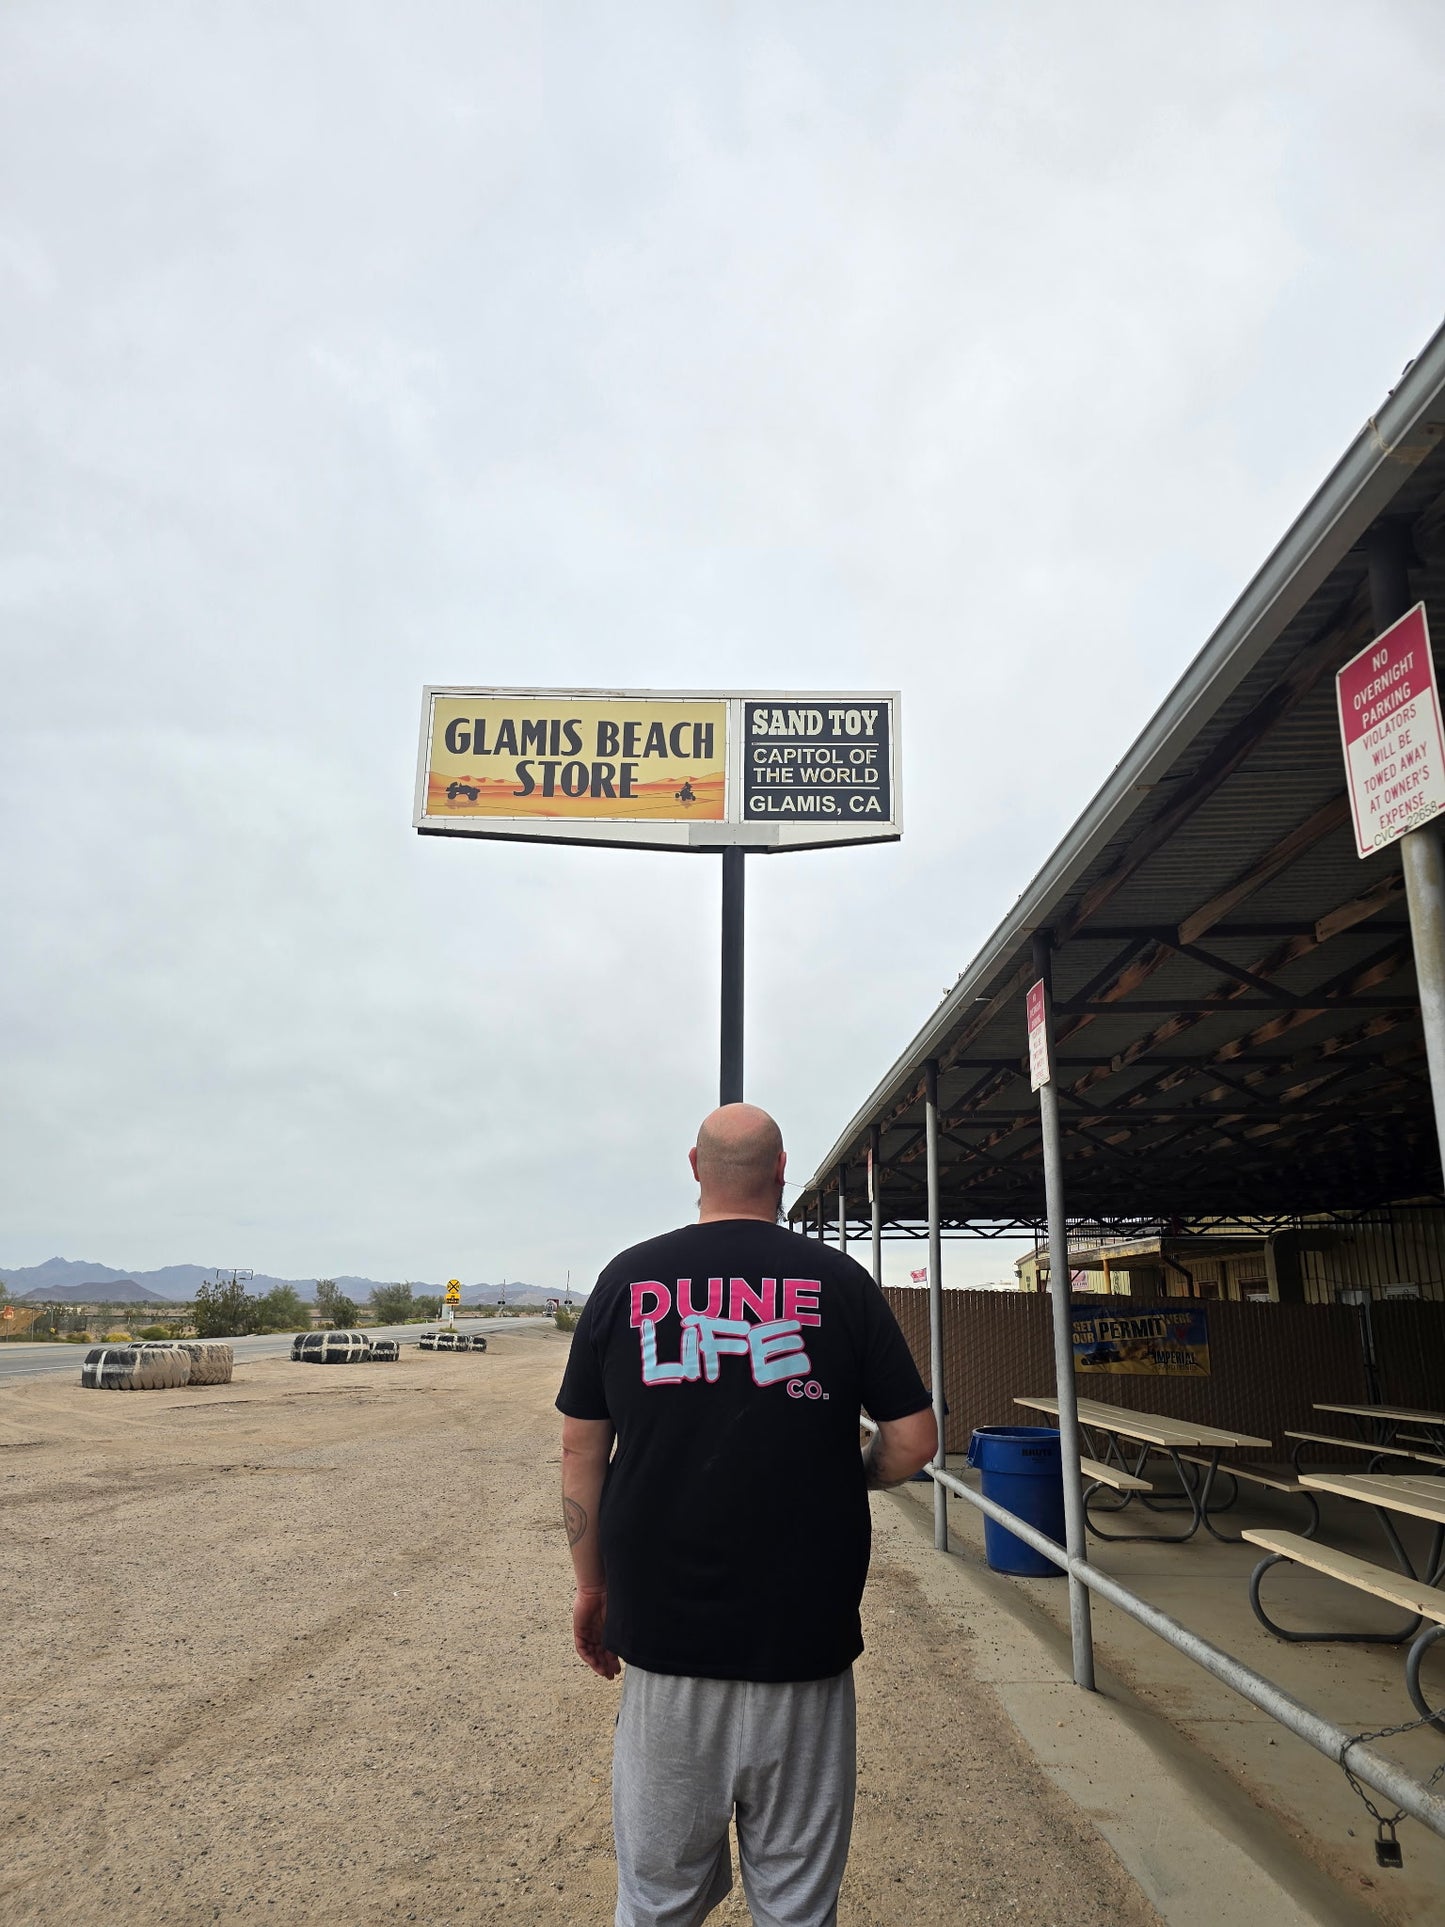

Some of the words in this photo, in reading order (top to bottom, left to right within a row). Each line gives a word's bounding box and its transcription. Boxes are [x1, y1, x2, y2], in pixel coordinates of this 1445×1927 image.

[1372, 648, 1388, 672] NO
[1353, 651, 1414, 711] OVERNIGHT
[752, 709, 824, 736] SAND
[828, 709, 879, 736] TOY
[1362, 681, 1411, 730] PARKING
[444, 718, 583, 756] GLAMIS
[596, 720, 714, 759] BEACH
[1362, 703, 1417, 751] VIOLATORS
[753, 748, 844, 764] CAPITOL
[849, 748, 878, 764] OF
[1372, 742, 1396, 766] WILL
[1398, 728, 1413, 749] BE
[513, 759, 639, 799] STORE
[753, 767, 794, 783] THE
[799, 767, 879, 783] WORLD
[1364, 763, 1397, 794] TOWED
[1400, 740, 1428, 772] AWAY
[749, 795, 842, 816] GLAMIS,
[849, 795, 882, 813] CA
[1370, 794, 1381, 815] AT
[1384, 764, 1430, 804] OWNER'S
[1374, 825, 1396, 847] CVC
[1406, 800, 1438, 829] 22658
[1379, 790, 1426, 829] EXPENSE
[630, 1278, 821, 1329] DUNE
[1098, 1317, 1164, 1340] PERMIT
[1154, 1350, 1196, 1365] IMPERIAL
[786, 1378, 830, 1400] CO.
